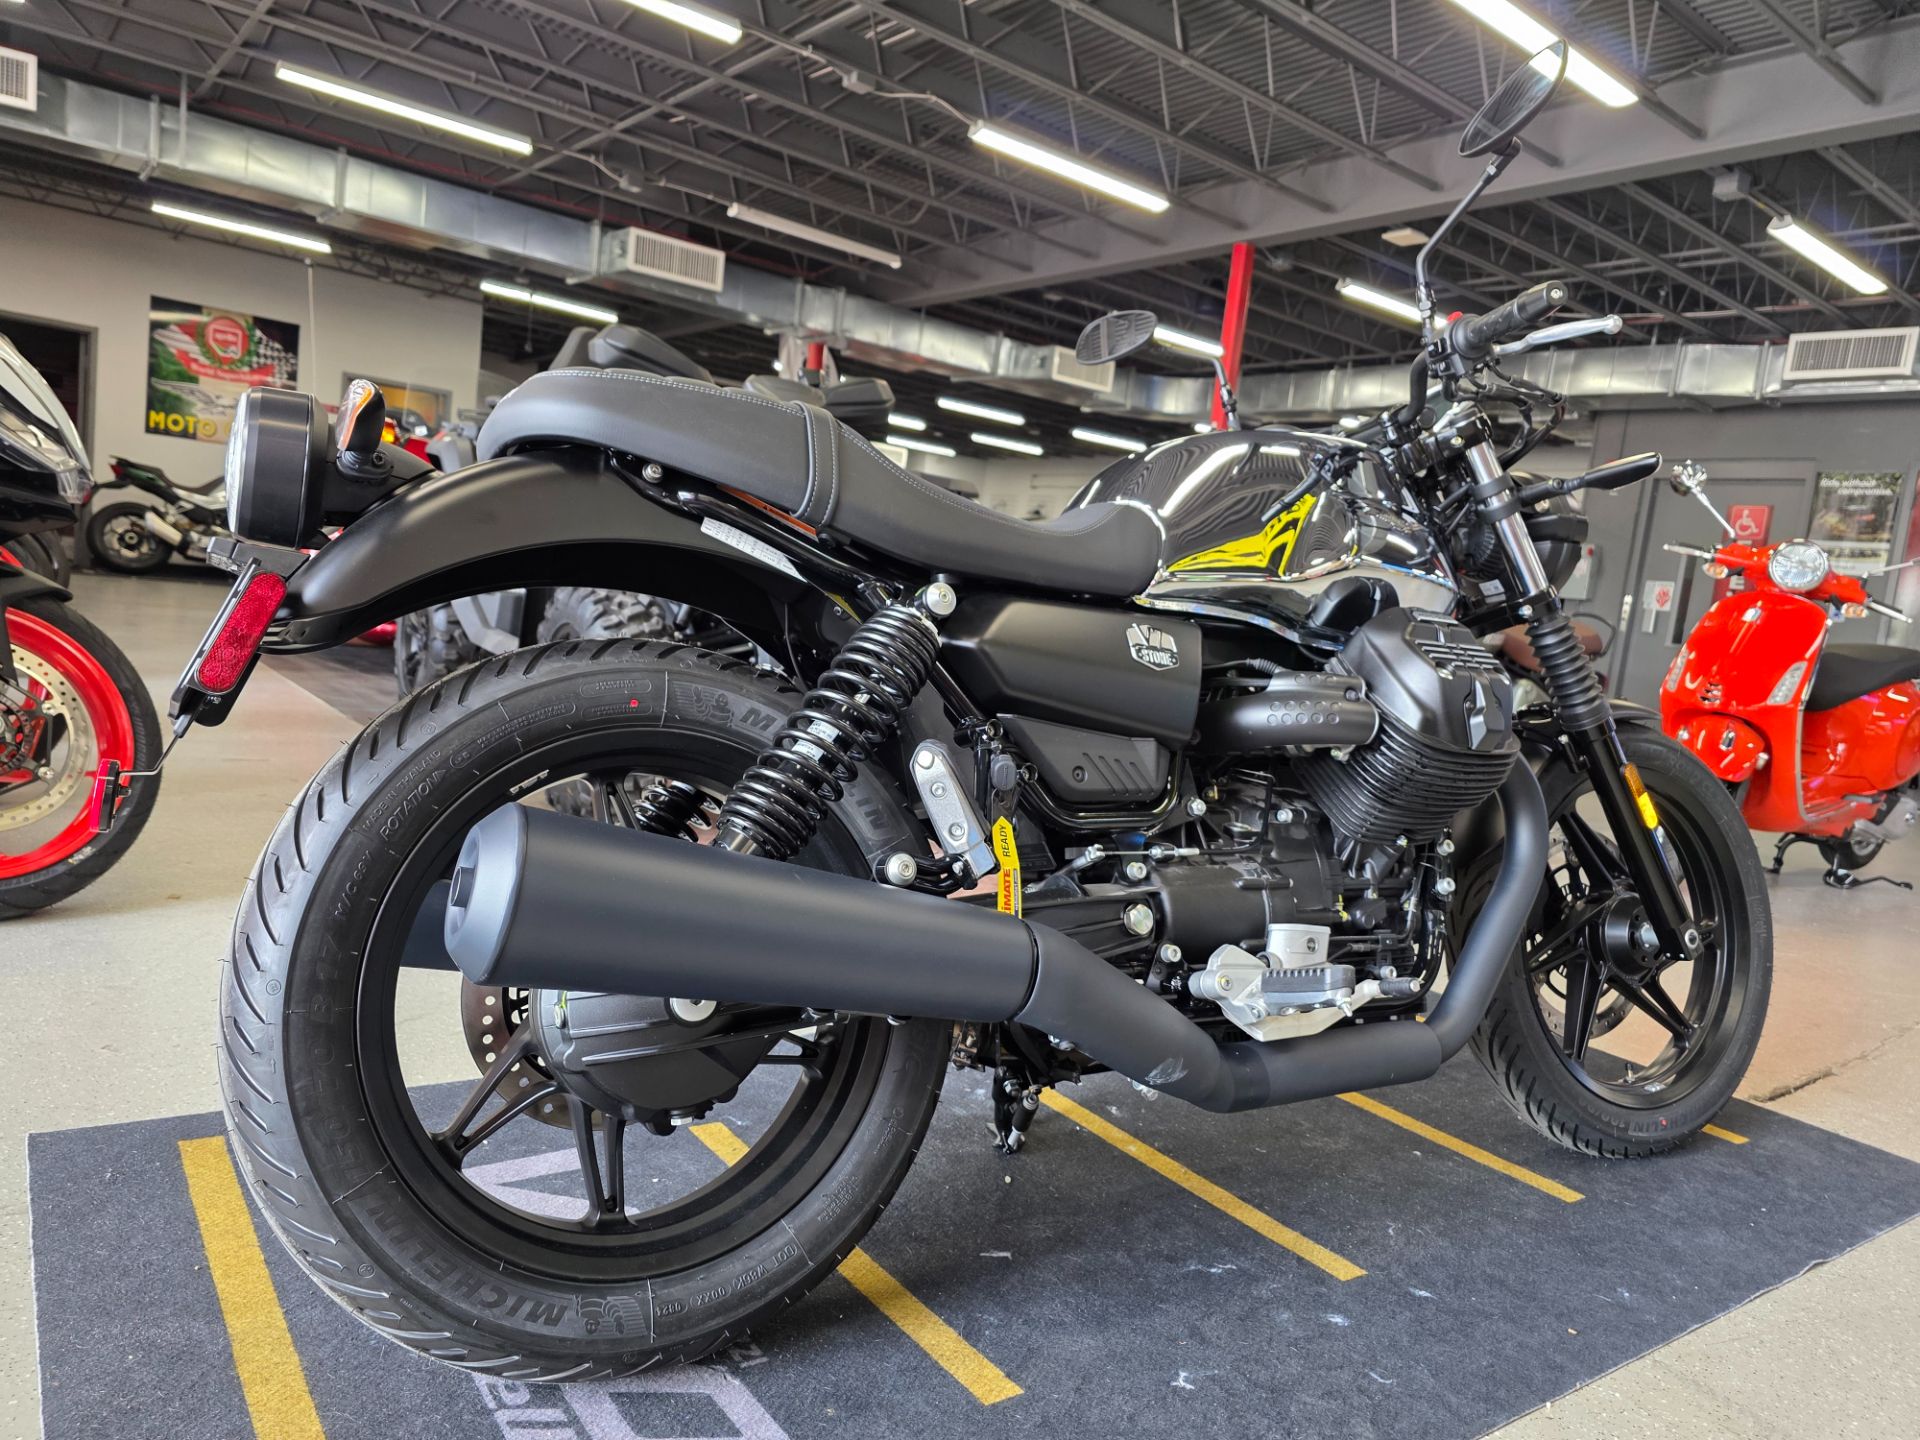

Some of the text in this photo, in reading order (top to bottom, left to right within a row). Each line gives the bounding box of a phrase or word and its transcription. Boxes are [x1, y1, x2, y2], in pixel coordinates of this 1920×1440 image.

[149, 410, 217, 438] MOTO
[1842, 477, 1877, 488] without
[1140, 649, 1173, 666] STONE
[362, 749, 442, 831] MADE IN THAILAND
[379, 771, 441, 841] ROTATION
[999, 824, 1012, 858] READY
[366, 1203, 568, 1327] MICHELIN
[772, 1244, 796, 1268] DOT
